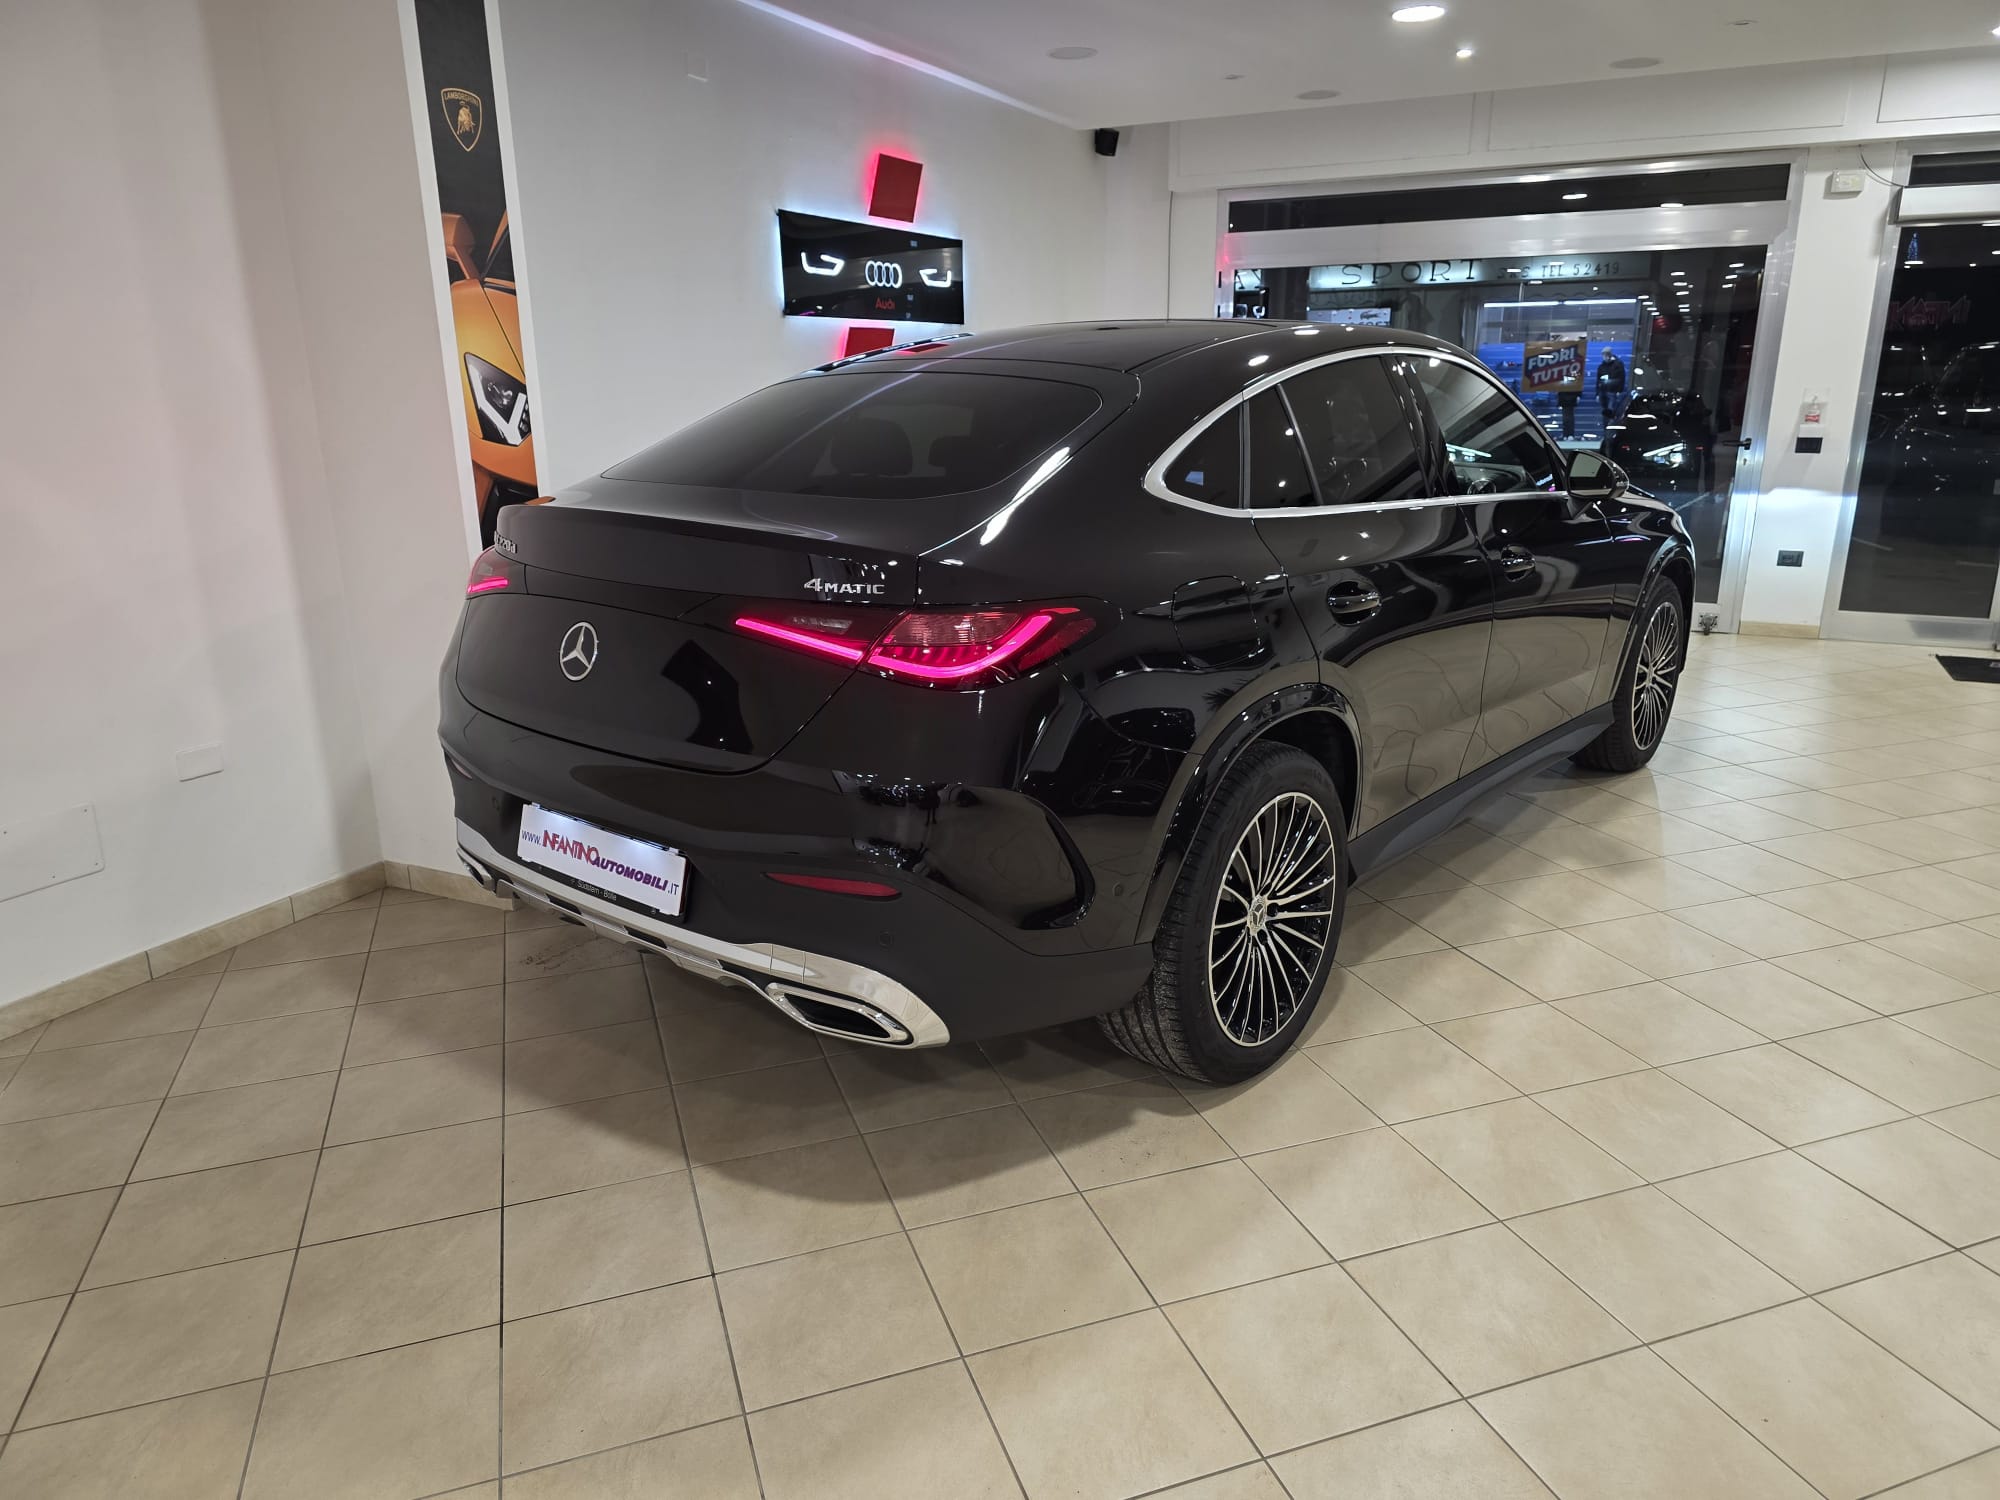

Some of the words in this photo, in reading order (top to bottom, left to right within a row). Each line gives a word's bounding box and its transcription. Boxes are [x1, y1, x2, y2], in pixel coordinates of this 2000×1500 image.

[1341, 258, 1482, 285] SPORT
[1541, 263, 1563, 278] TEL
[875, 297, 896, 310] Audi
[1527, 346, 1576, 371] FUORI
[1532, 361, 1581, 385] TUTTO
[803, 577, 885, 595] 4MATIC
